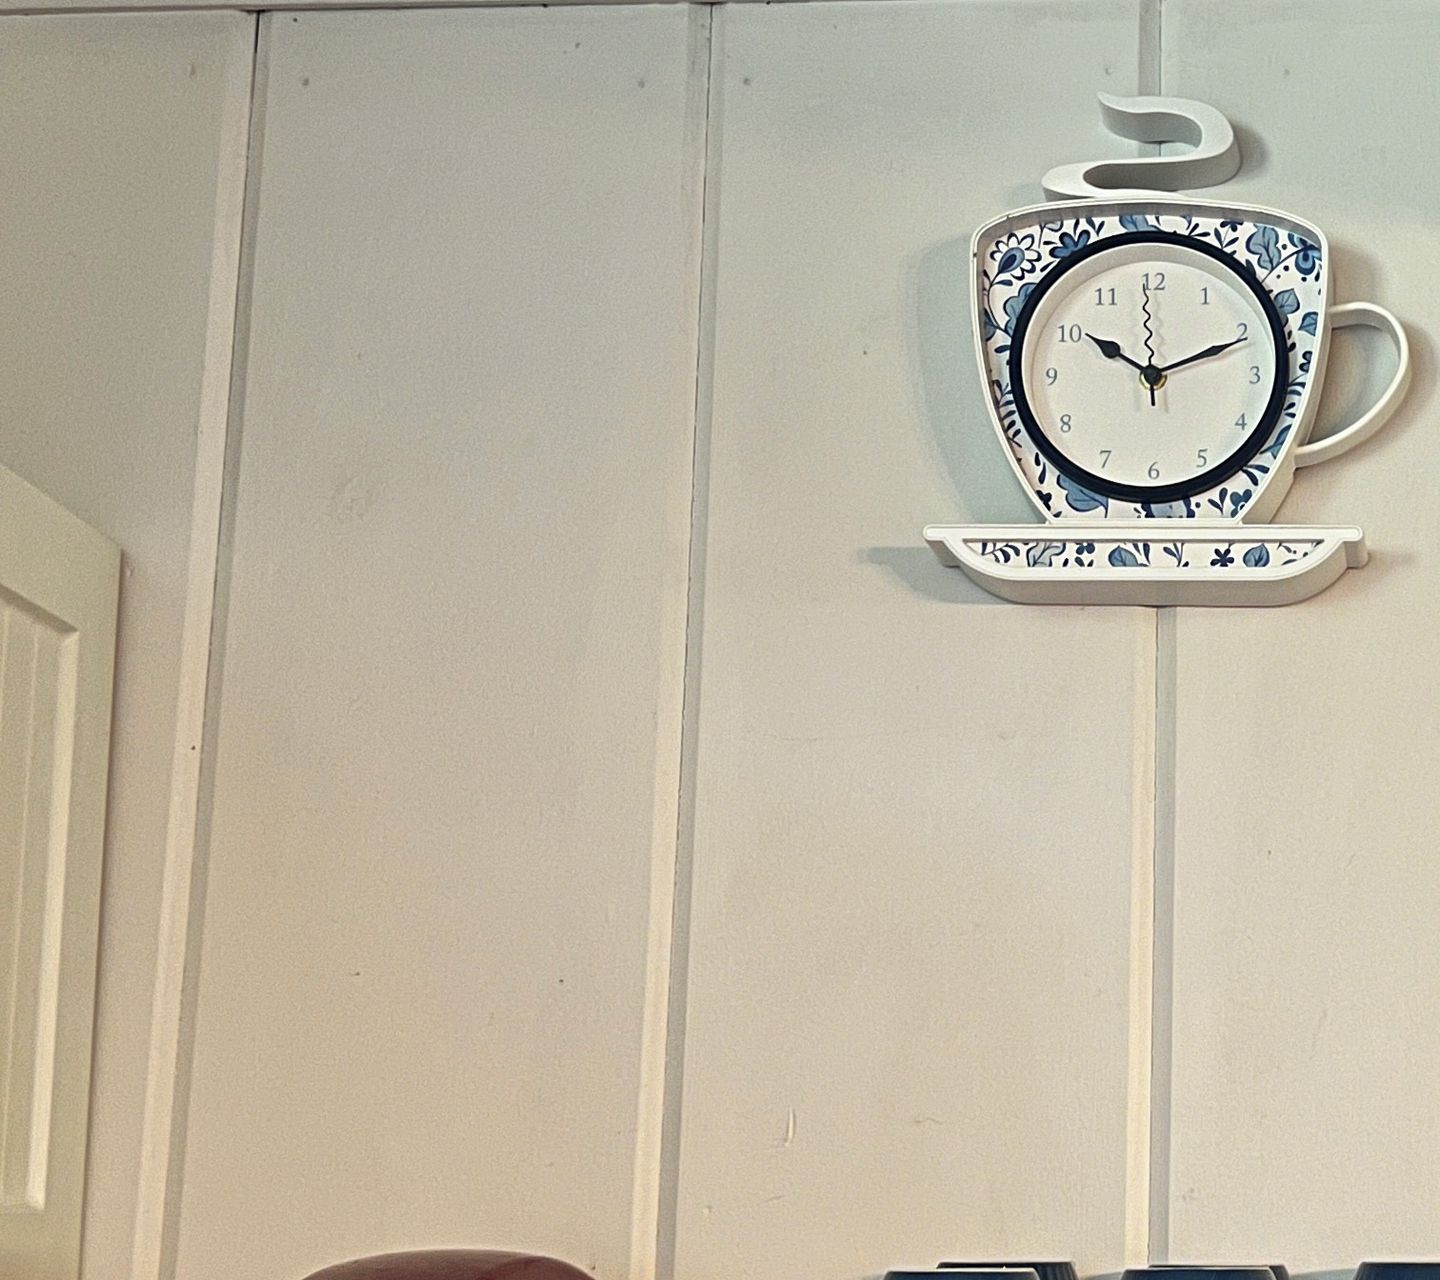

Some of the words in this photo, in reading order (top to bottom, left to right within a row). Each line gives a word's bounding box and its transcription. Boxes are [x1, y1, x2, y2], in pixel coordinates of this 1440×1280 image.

[1142, 272, 1166, 291] 12
[1095, 288, 1118, 306] 11
[1200, 286, 1210, 305] 1
[1057, 324, 1082, 343] 10
[1236, 323, 1248, 342] 2
[1045, 367, 1058, 386] 9
[1249, 366, 1261, 385] 3
[1060, 414, 1072, 433] 8
[1234, 413, 1248, 431] 4
[1100, 450, 1112, 468] 7
[1196, 449, 1208, 468] 5
[1147, 461, 1160, 480] 6
